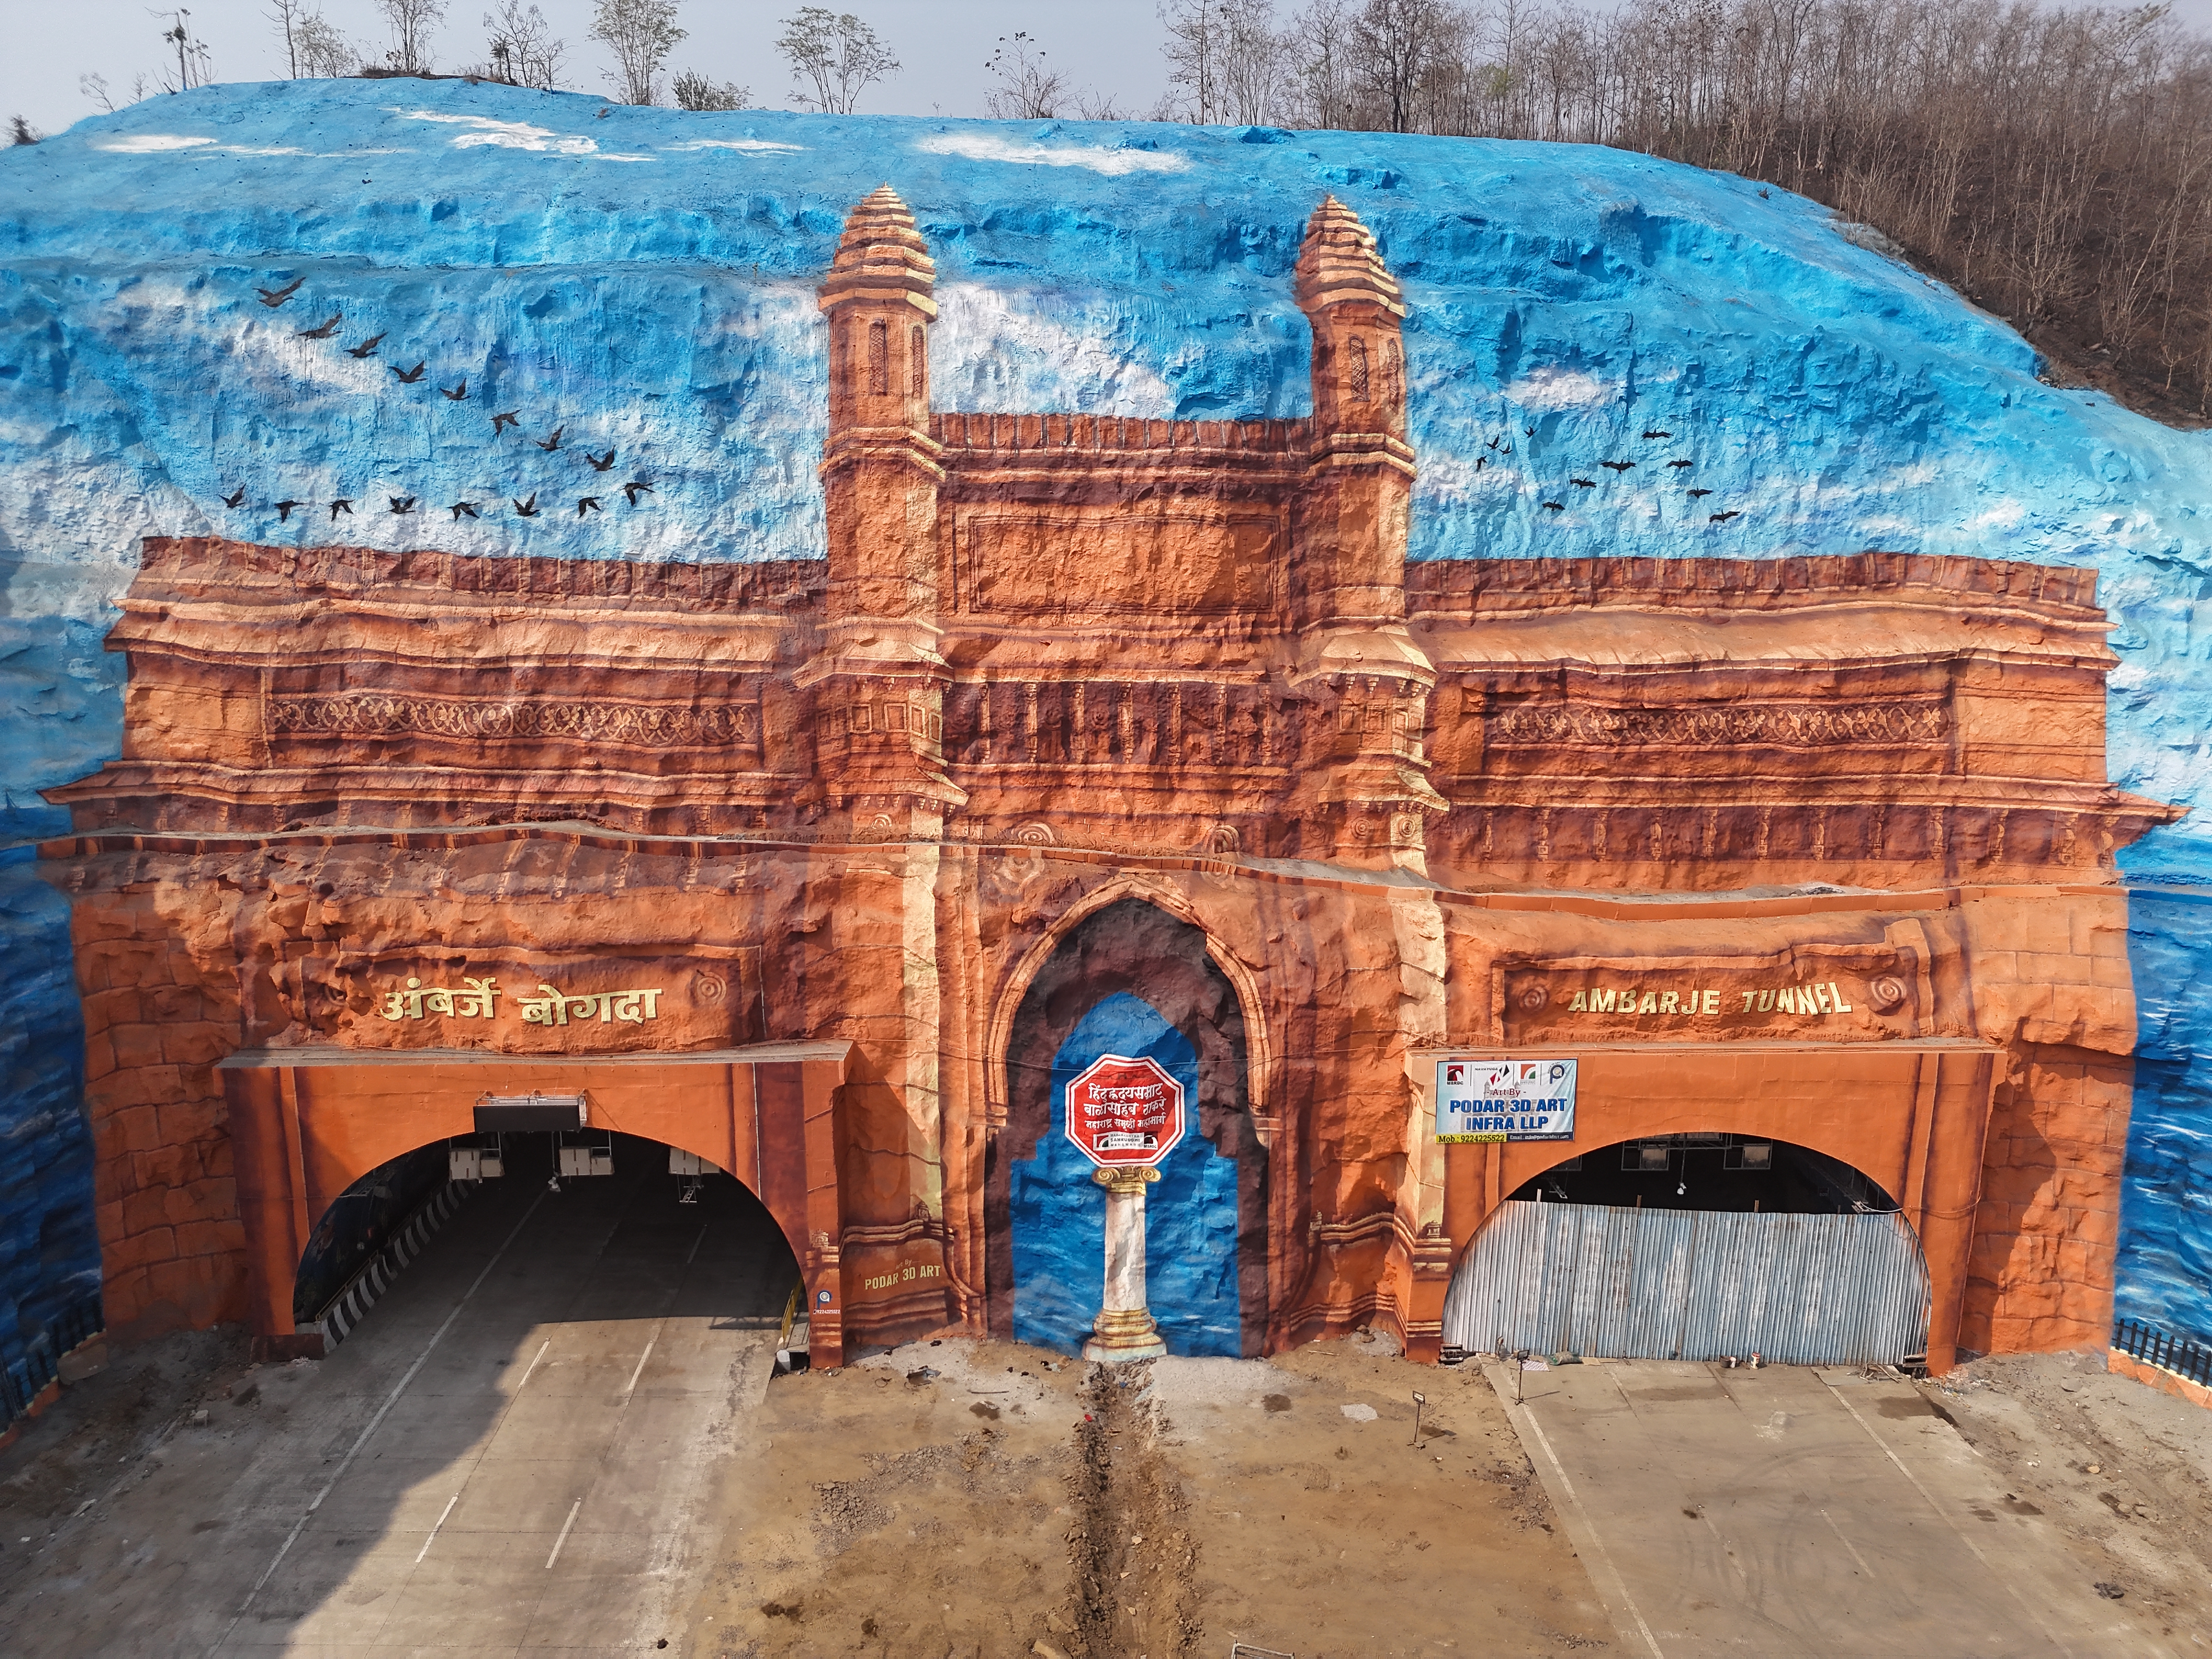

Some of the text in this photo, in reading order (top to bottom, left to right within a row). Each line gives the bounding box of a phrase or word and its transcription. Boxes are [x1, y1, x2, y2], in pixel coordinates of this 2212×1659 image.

[380, 977, 663, 1025] अंबर्जे बोगदा
[1567, 981, 1853, 1015] AMBARJE TUNNEL
[1509, 1088, 1521, 1097] By
[1143, 1096, 1167, 1115] ठाकरे
[1449, 1098, 1567, 1113] PODAR 3D ART
[1466, 1116, 1549, 1130] INFRA LLP
[865, 1265, 941, 1290] PODAR 3D ART
